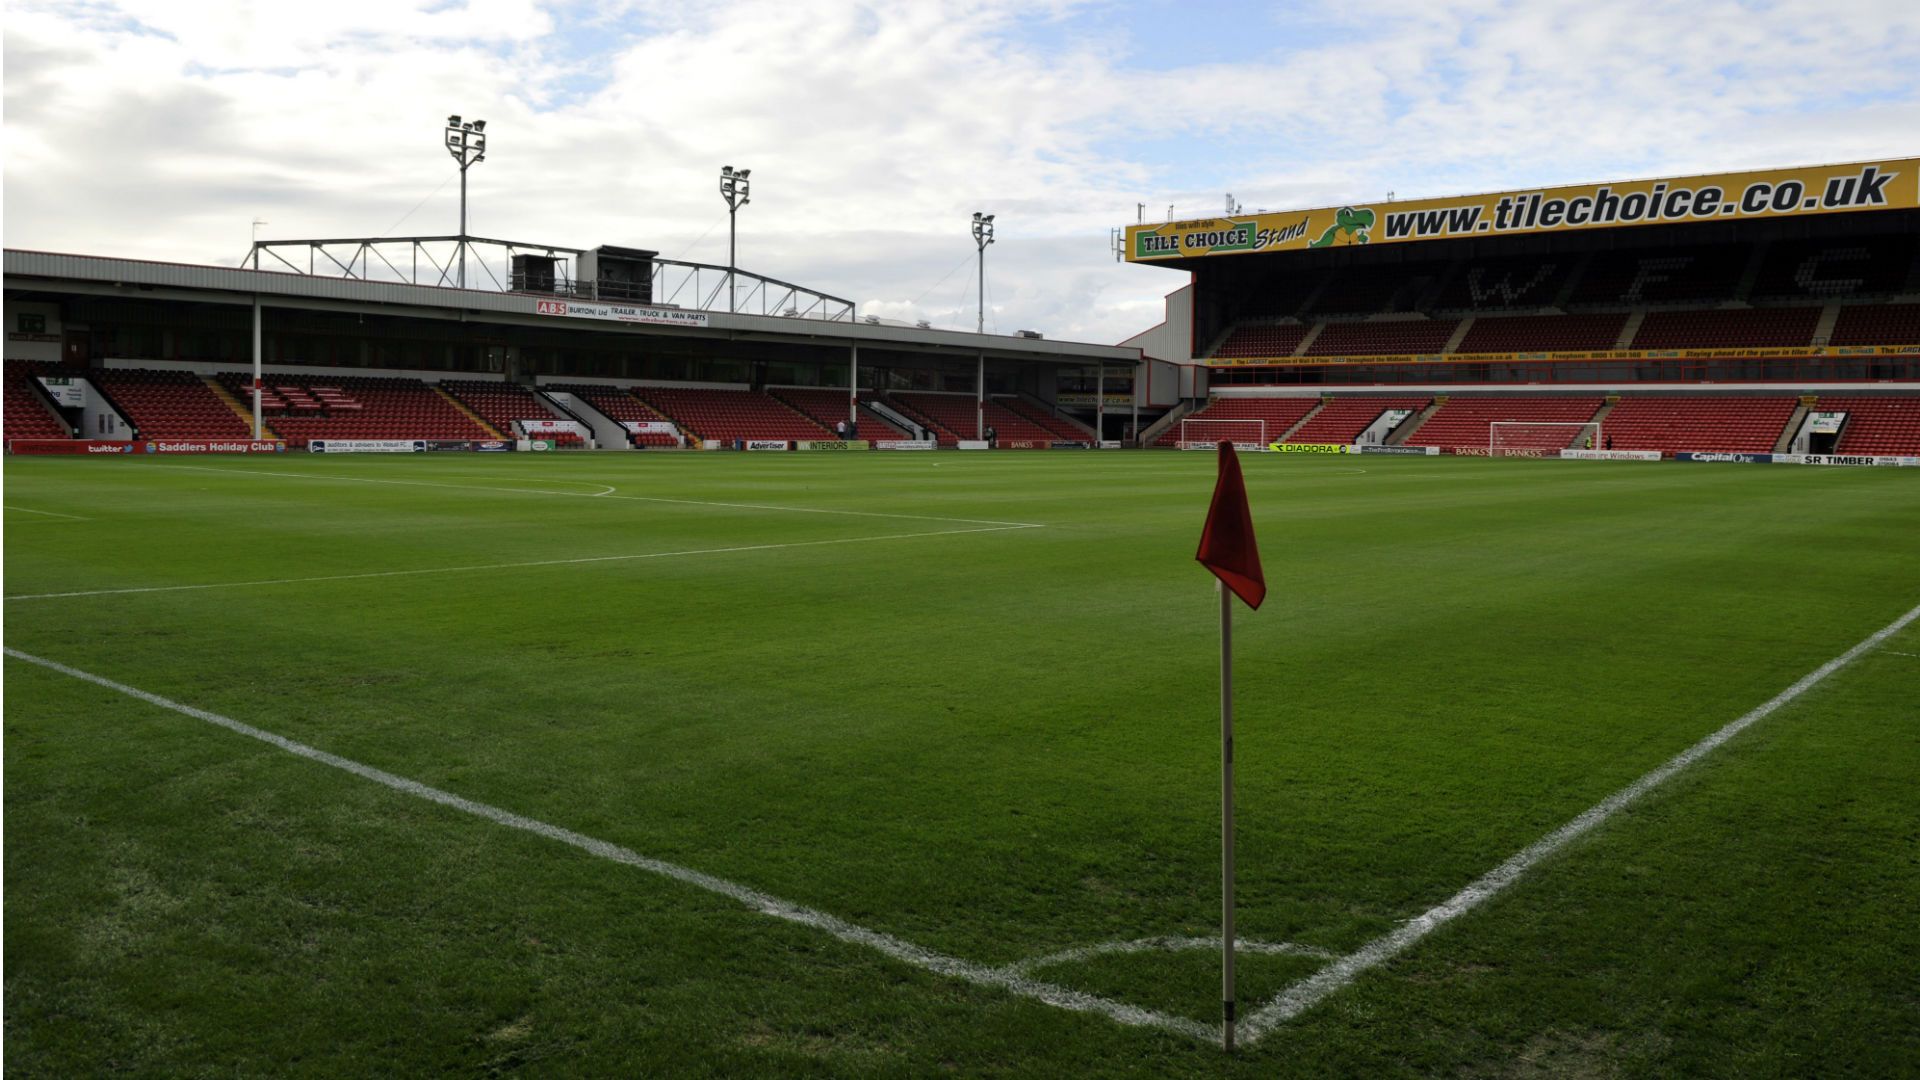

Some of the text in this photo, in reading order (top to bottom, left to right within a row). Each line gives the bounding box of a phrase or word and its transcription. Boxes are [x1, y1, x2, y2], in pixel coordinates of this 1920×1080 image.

[1384, 165, 1899, 240] www.tilechoice.co.uk
[1188, 220, 1200, 229] with
[1144, 216, 1309, 251] TILE CHOICE Stand
[539, 302, 566, 314] ABS
[598, 308, 608, 316] Ltd
[640, 309, 659, 317] TRUCK
[687, 313, 706, 321] PARTS
[1685, 350, 1712, 358] Staying
[88, 444, 122, 453] twitter
[159, 442, 275, 453] Saddlers Holiday Club
[750, 441, 785, 449] Advertiser
[810, 441, 848, 450] INTERIORS
[1286, 444, 1333, 453] DIADORA
[1576, 451, 1645, 460] Leamre Windows
[1805, 455, 1822, 465] SR
[1826, 456, 1874, 466] TIMBER
